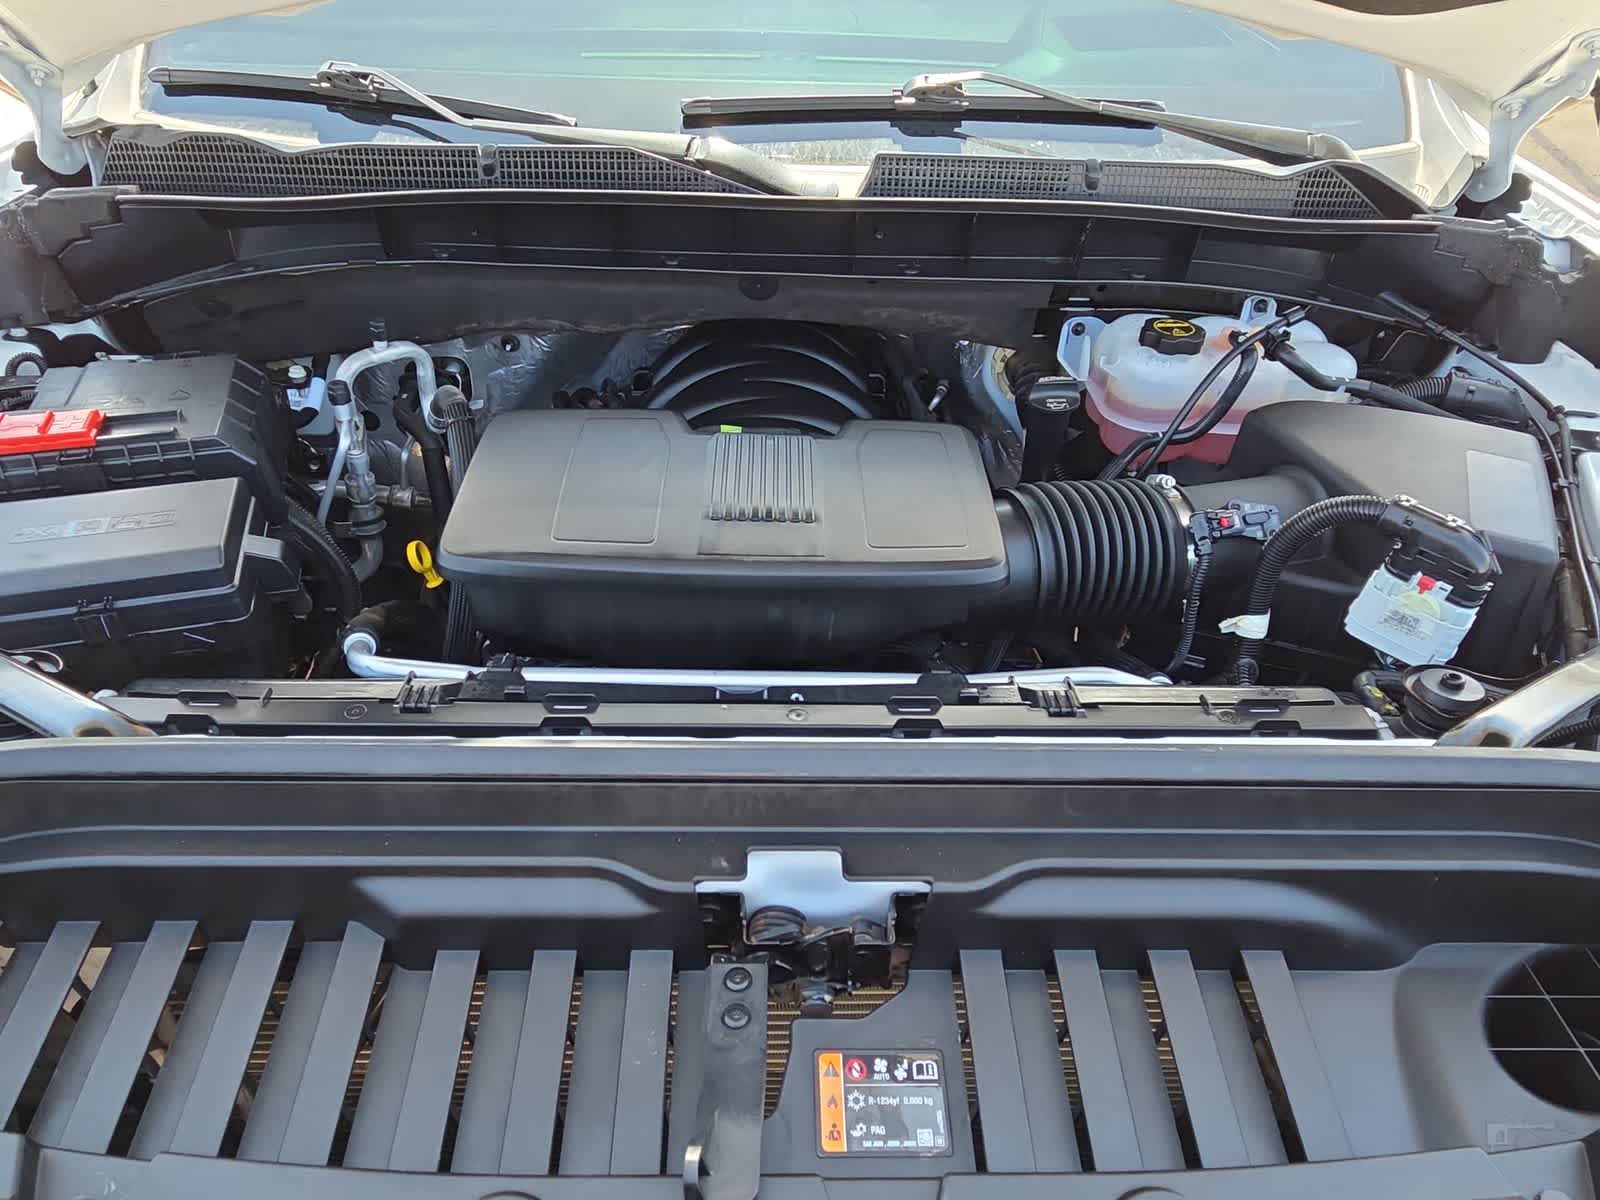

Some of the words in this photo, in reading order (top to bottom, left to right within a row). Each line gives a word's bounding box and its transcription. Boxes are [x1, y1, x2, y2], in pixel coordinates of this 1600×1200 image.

[873, 1073, 890, 1081] AUTO
[868, 1096, 900, 1107] R-1234yf
[924, 1096, 934, 1107] kg
